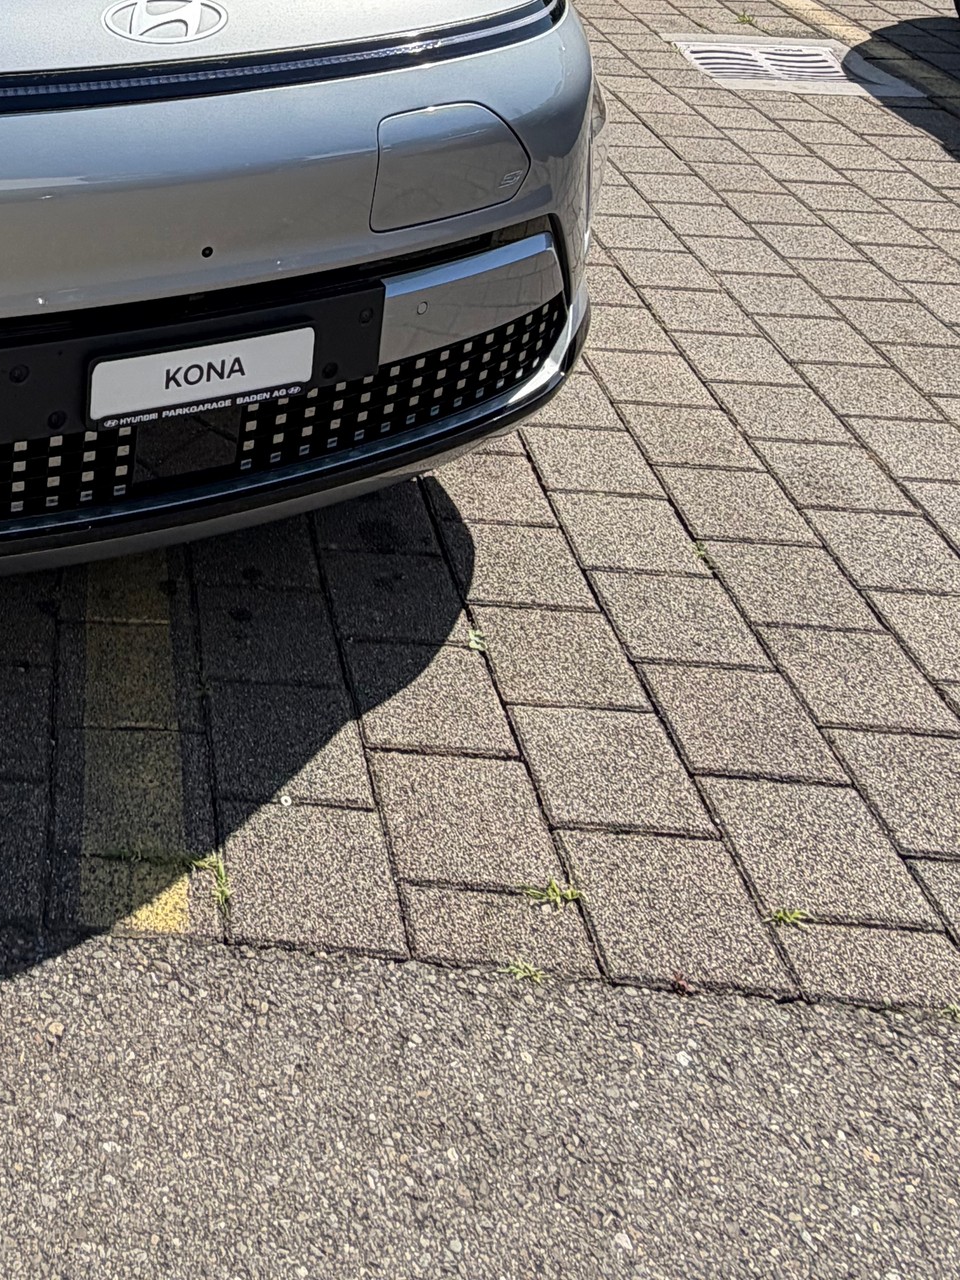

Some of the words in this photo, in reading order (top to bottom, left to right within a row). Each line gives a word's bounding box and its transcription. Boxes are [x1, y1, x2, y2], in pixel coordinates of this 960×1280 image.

[164, 357, 246, 390] KONA
[119, 412, 158, 426] HYUNDAI
[162, 399, 232, 418] PARKGARAGE
[236, 391, 271, 405] BADEN
[272, 388, 287, 399] AG
